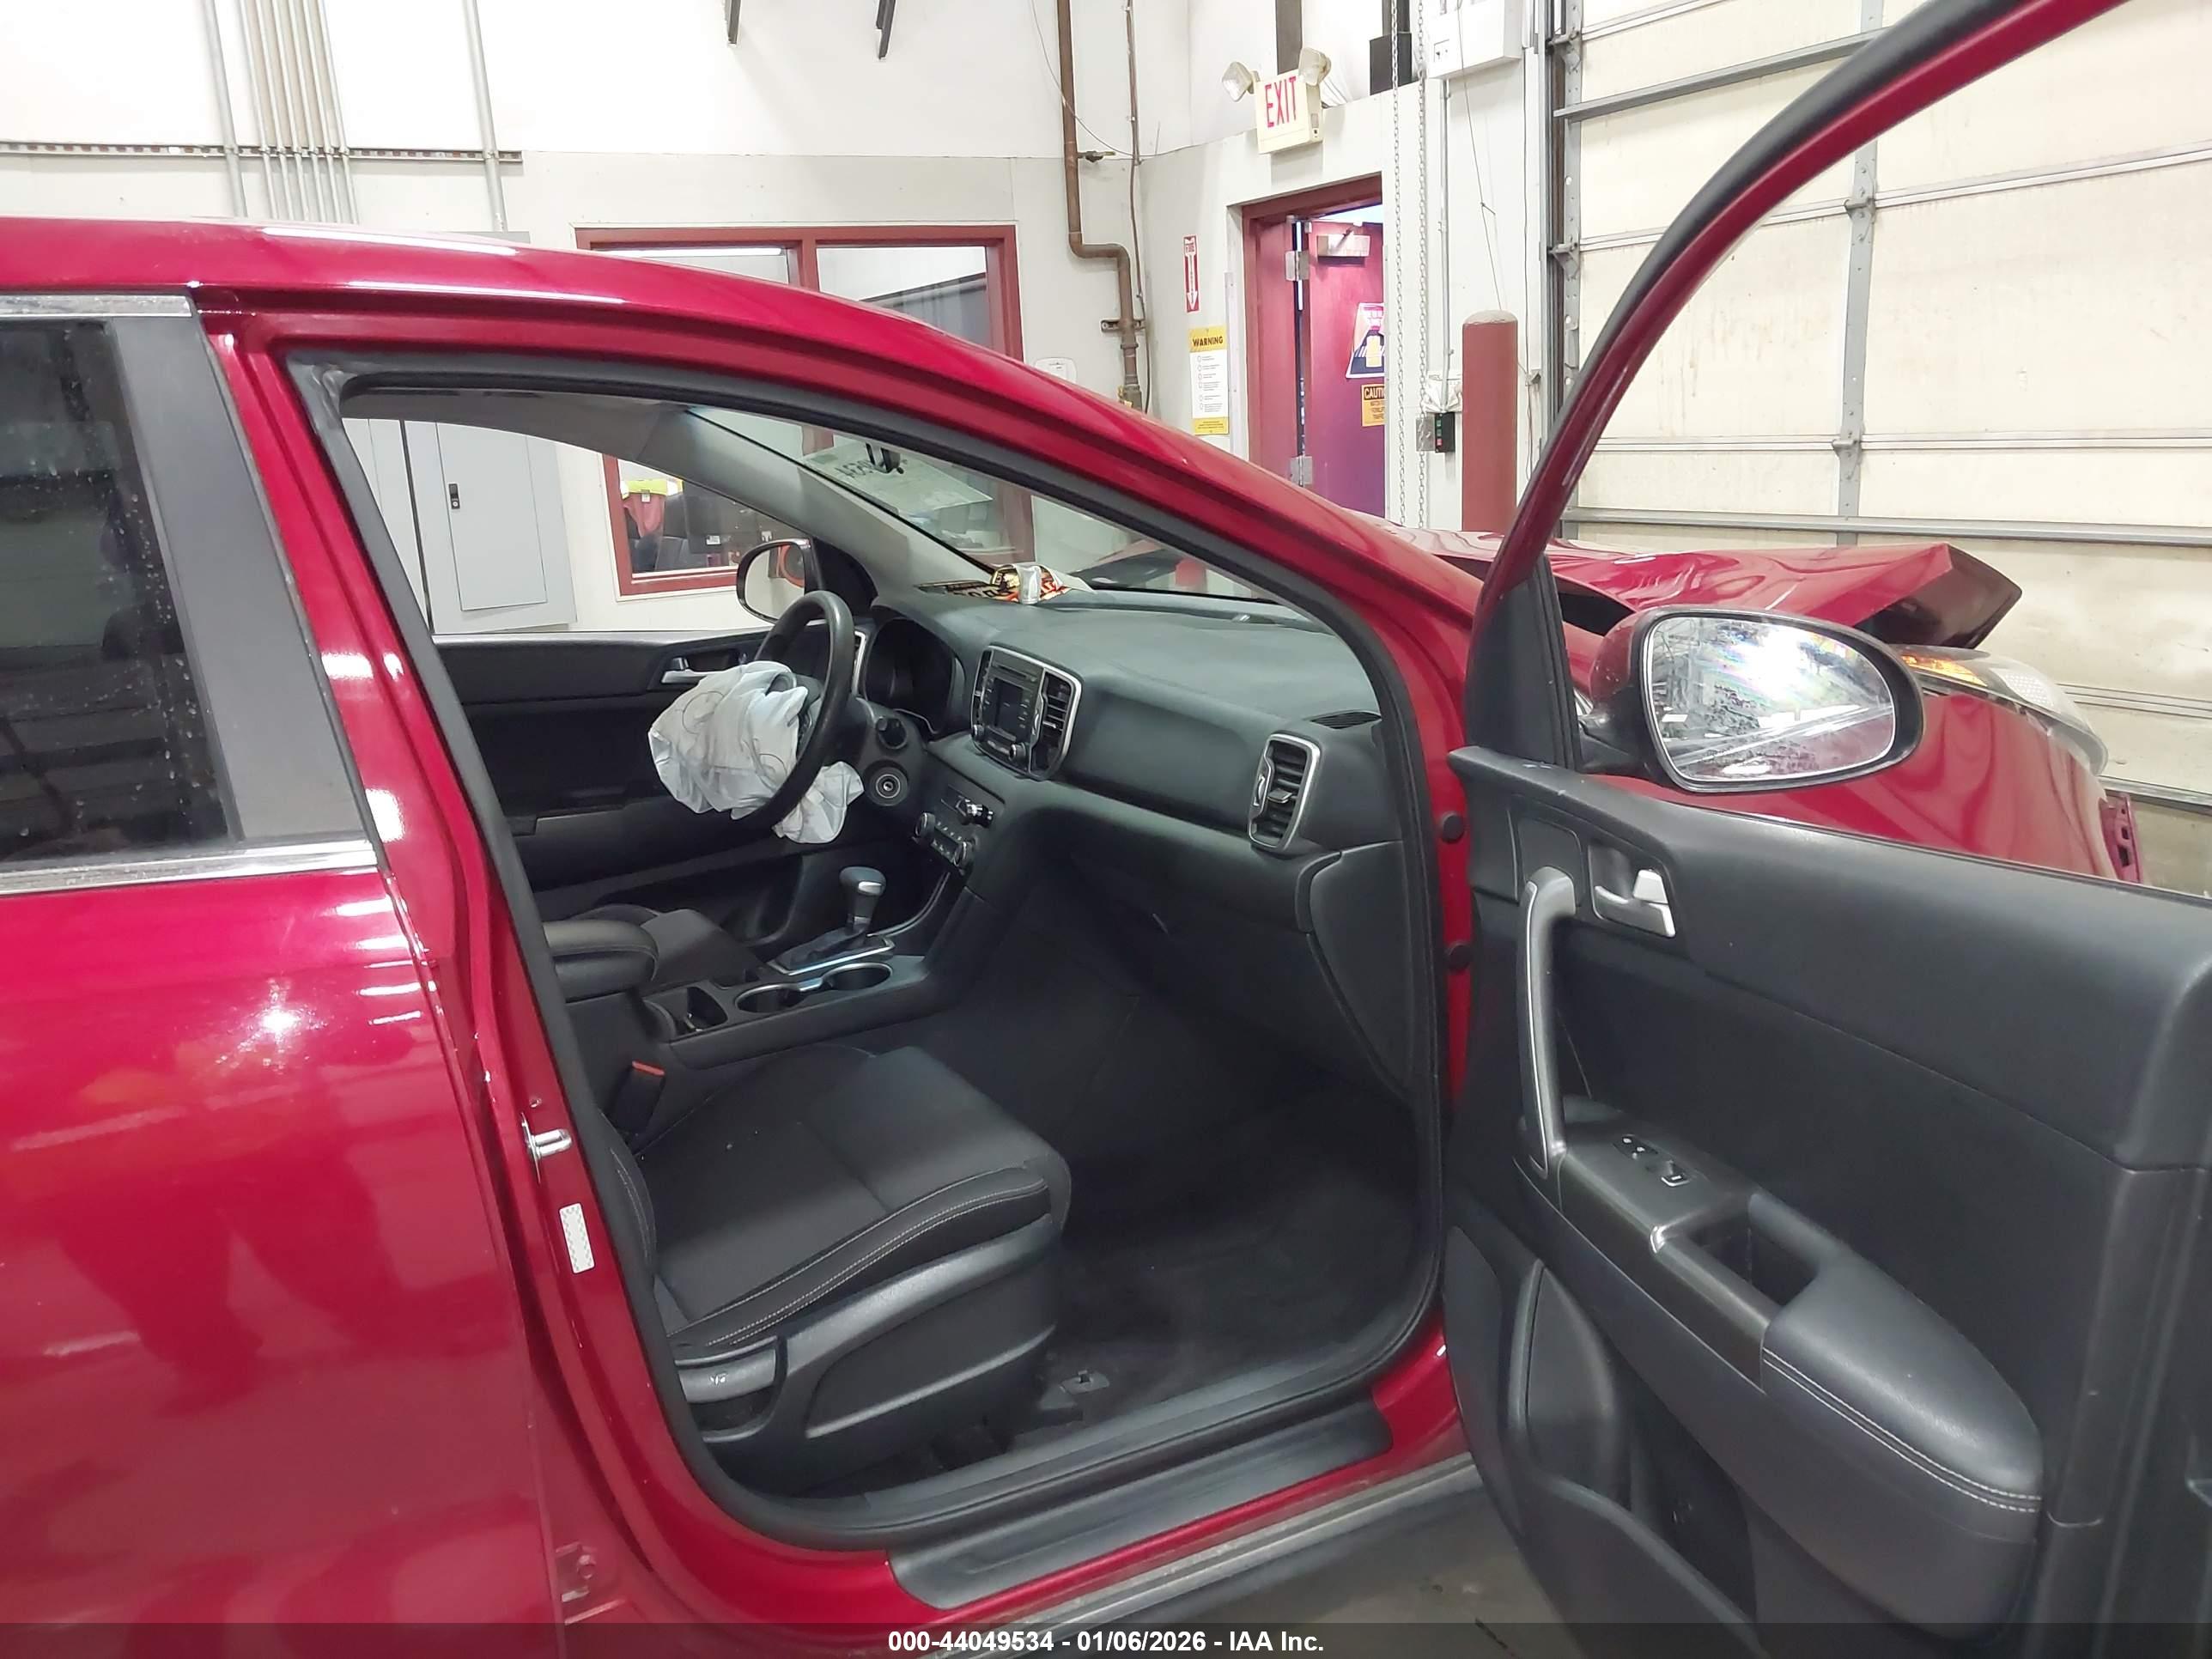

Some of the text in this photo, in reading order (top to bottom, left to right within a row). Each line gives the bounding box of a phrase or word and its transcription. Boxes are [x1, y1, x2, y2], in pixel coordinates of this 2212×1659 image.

[1265, 76, 1297, 128] EXIT
[1193, 336, 1224, 347] WARNING
[1364, 387, 1383, 399] CAUTI
